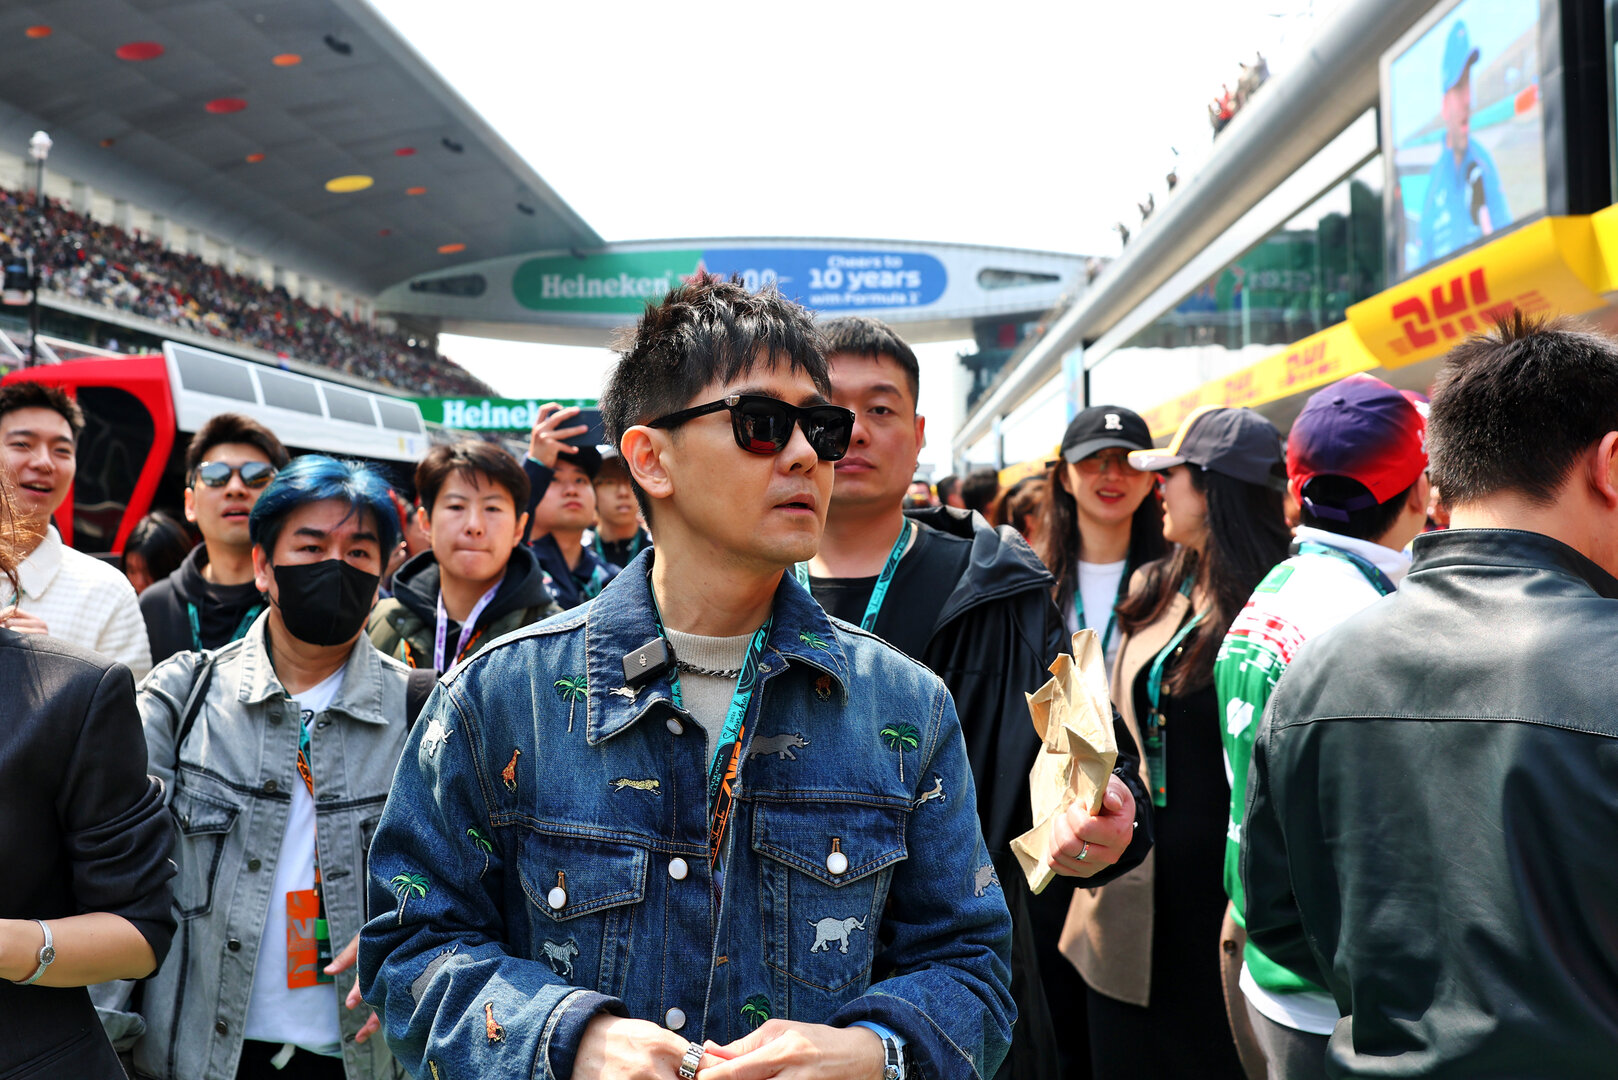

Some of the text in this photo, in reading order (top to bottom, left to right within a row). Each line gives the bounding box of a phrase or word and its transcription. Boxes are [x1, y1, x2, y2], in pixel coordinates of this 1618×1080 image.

[827, 255, 903, 268] Cheers to
[541, 272, 669, 298] Heineken
[809, 267, 921, 292] 10 years
[1391, 267, 1489, 349] DHL
[709, 753, 724, 790] ADDOCK
[711, 773, 722, 796] CLUB
